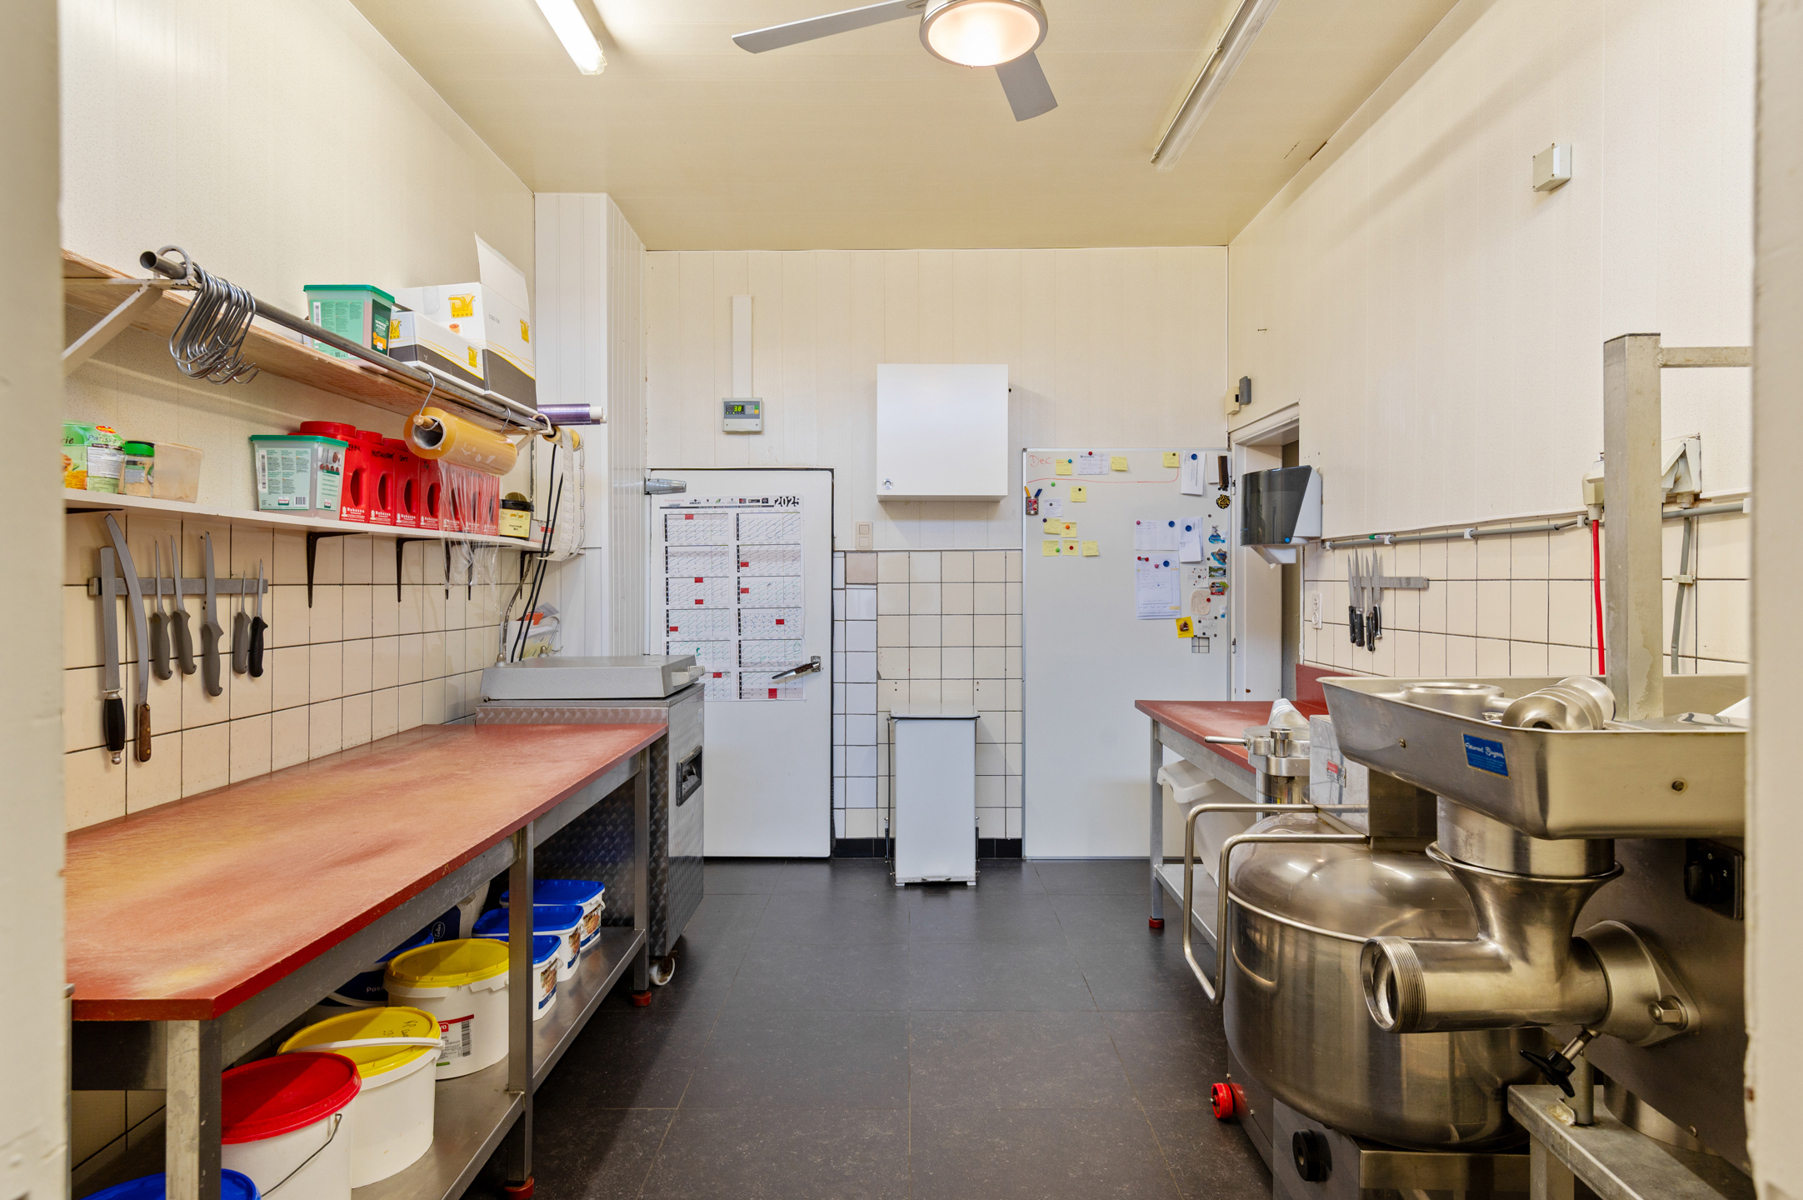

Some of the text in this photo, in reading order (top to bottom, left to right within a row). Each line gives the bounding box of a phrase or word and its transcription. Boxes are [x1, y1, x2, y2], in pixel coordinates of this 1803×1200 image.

[1029, 454, 1052, 467] Dec
[774, 496, 800, 507] 2025
[1722, 869, 1728, 877] 2
